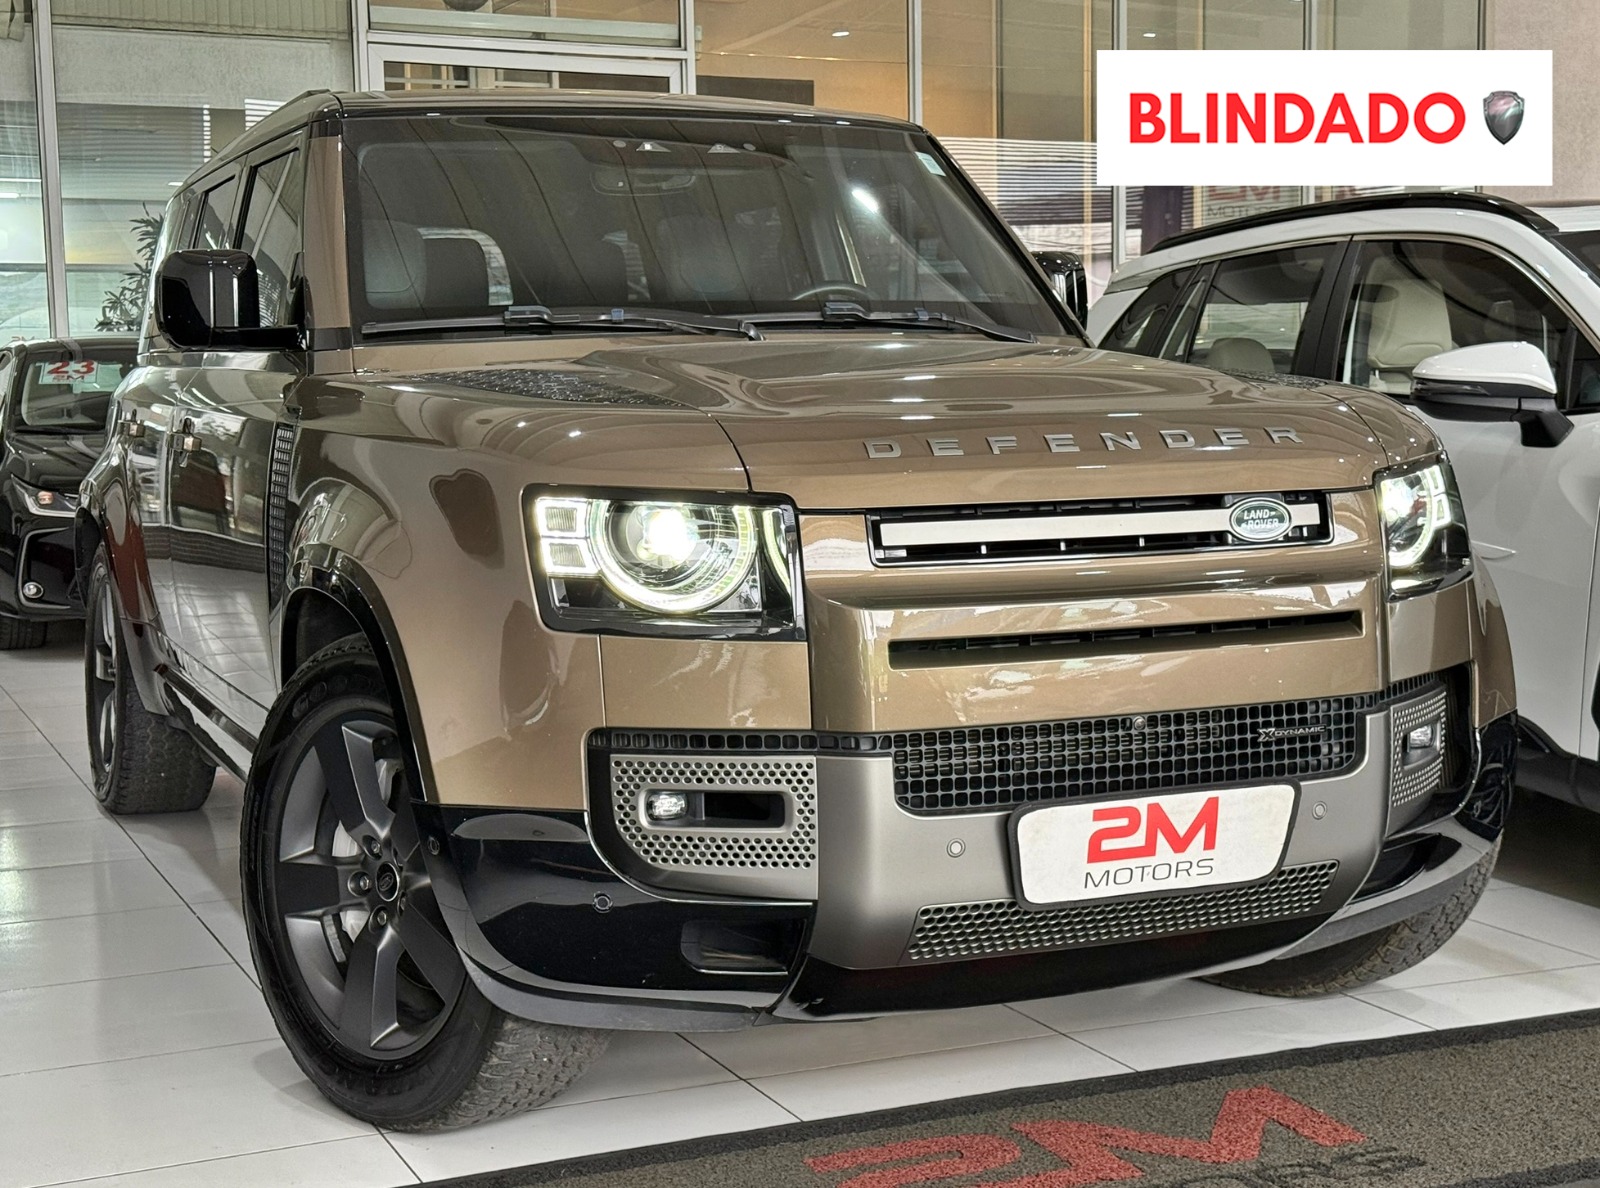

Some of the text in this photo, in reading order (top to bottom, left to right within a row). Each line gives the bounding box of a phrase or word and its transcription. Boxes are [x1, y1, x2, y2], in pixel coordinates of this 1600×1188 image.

[47, 360, 95, 375] 23
[863, 425, 1304, 459] DEFENDER
[1243, 508, 1270, 520] LAND
[1247, 518, 1279, 529] ROVER
[1087, 797, 1220, 864] 2M
[1084, 858, 1215, 889] MOTORS
